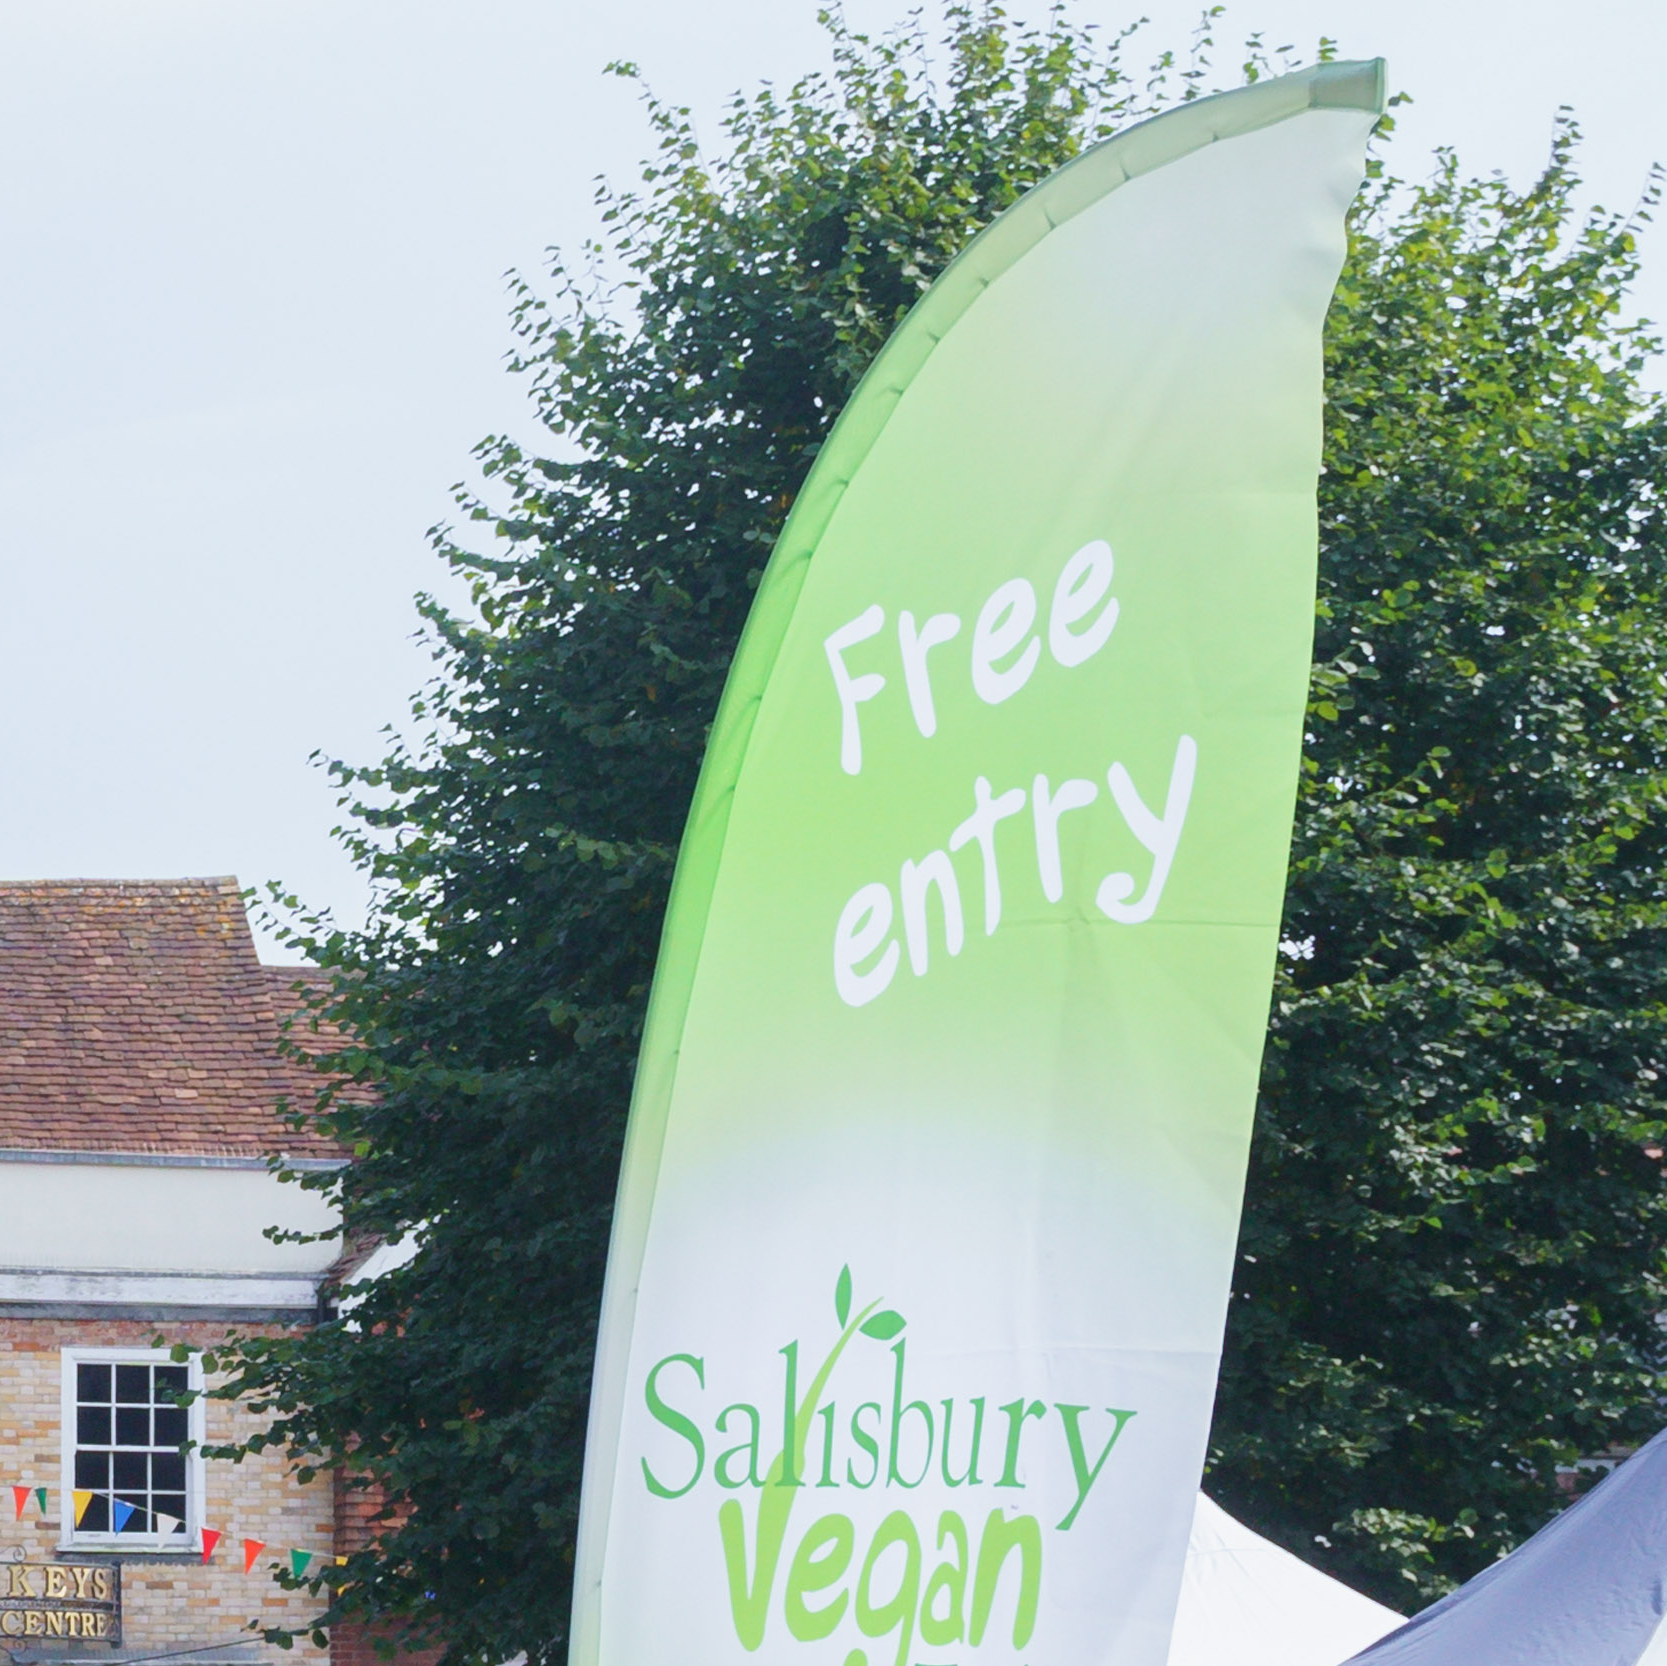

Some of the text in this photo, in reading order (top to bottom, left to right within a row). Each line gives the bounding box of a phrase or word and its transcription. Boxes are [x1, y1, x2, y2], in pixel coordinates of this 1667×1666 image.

[824, 539, 1120, 777] Free
[834, 734, 1198, 1009] entry
[640, 1338, 1137, 1531] Salisbury
[0, 1610, 108, 1638] CENTRE
[8, 1564, 108, 1600] KEYS
